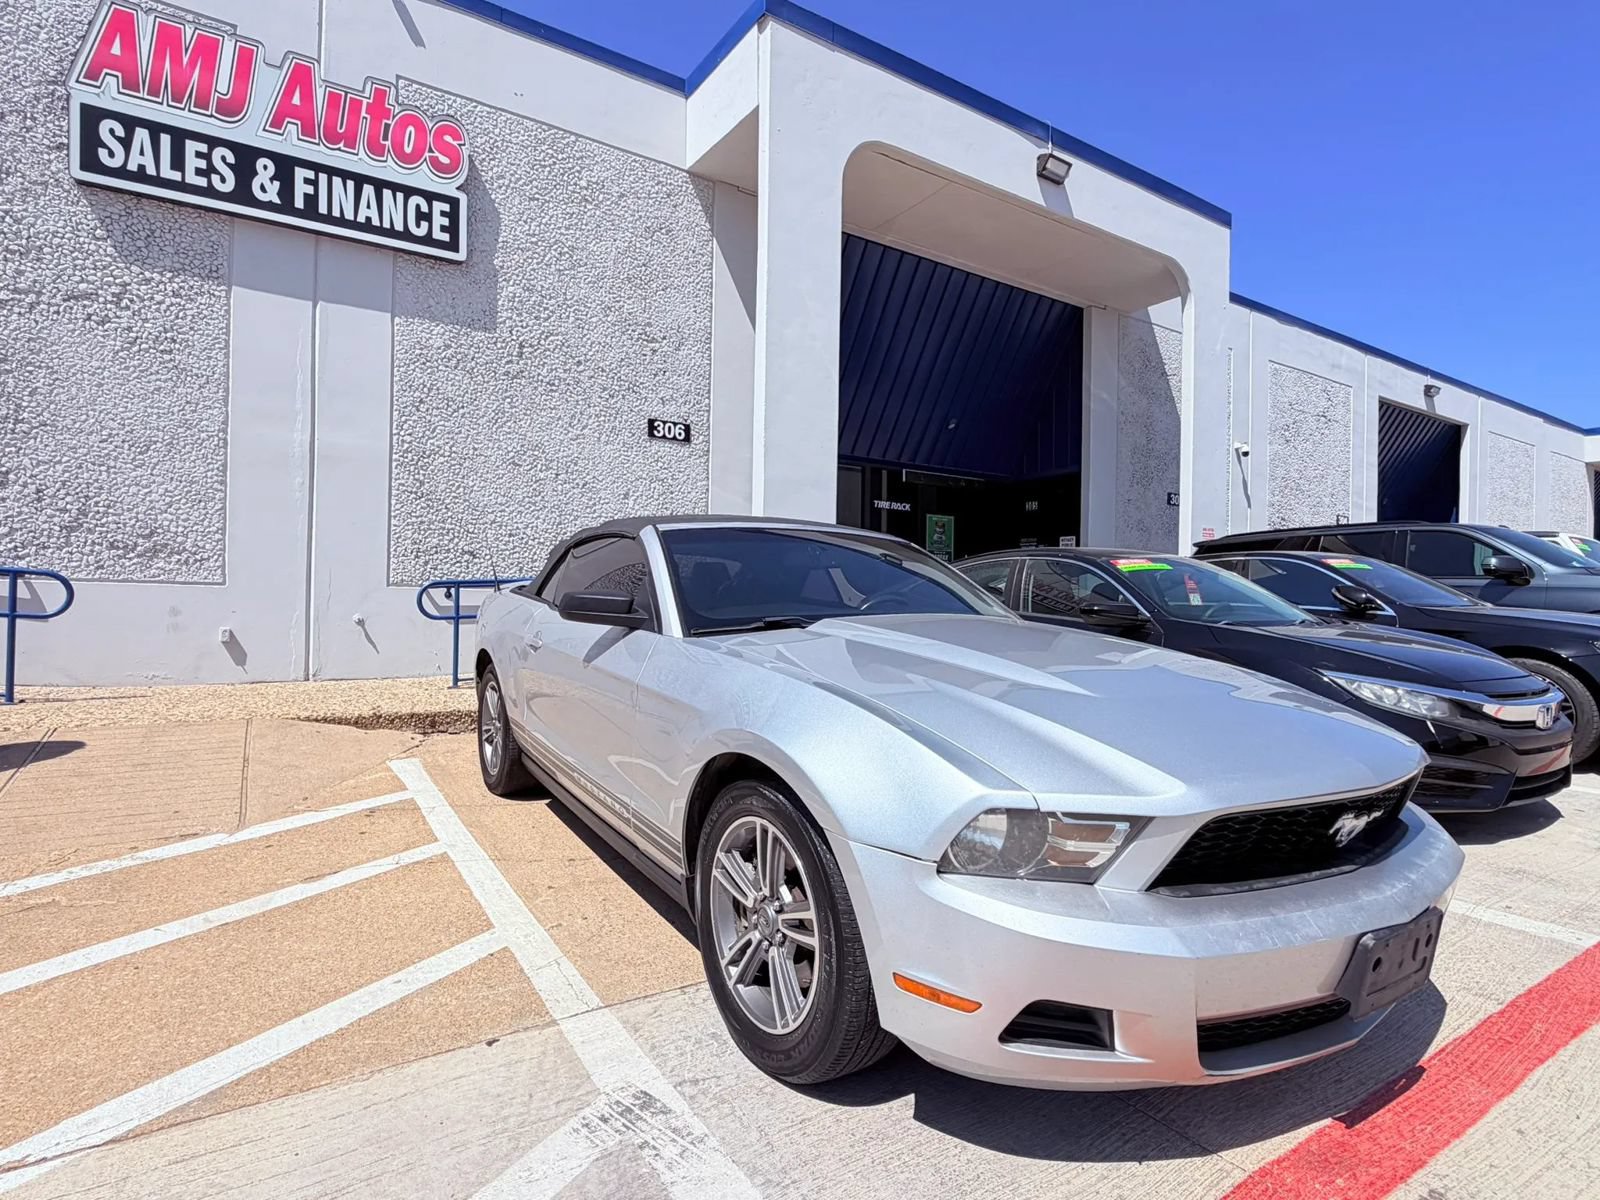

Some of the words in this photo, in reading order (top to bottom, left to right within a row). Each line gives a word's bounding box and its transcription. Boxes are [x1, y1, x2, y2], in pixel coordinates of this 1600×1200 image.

[80, 5, 260, 119] AMJ
[267, 57, 465, 177] Autos
[98, 118, 236, 194] SALES
[251, 157, 282, 205] &
[294, 166, 451, 242] FINANCE
[653, 421, 686, 440] 306
[873, 500, 890, 509] TIRE
[891, 501, 911, 511] RACK
